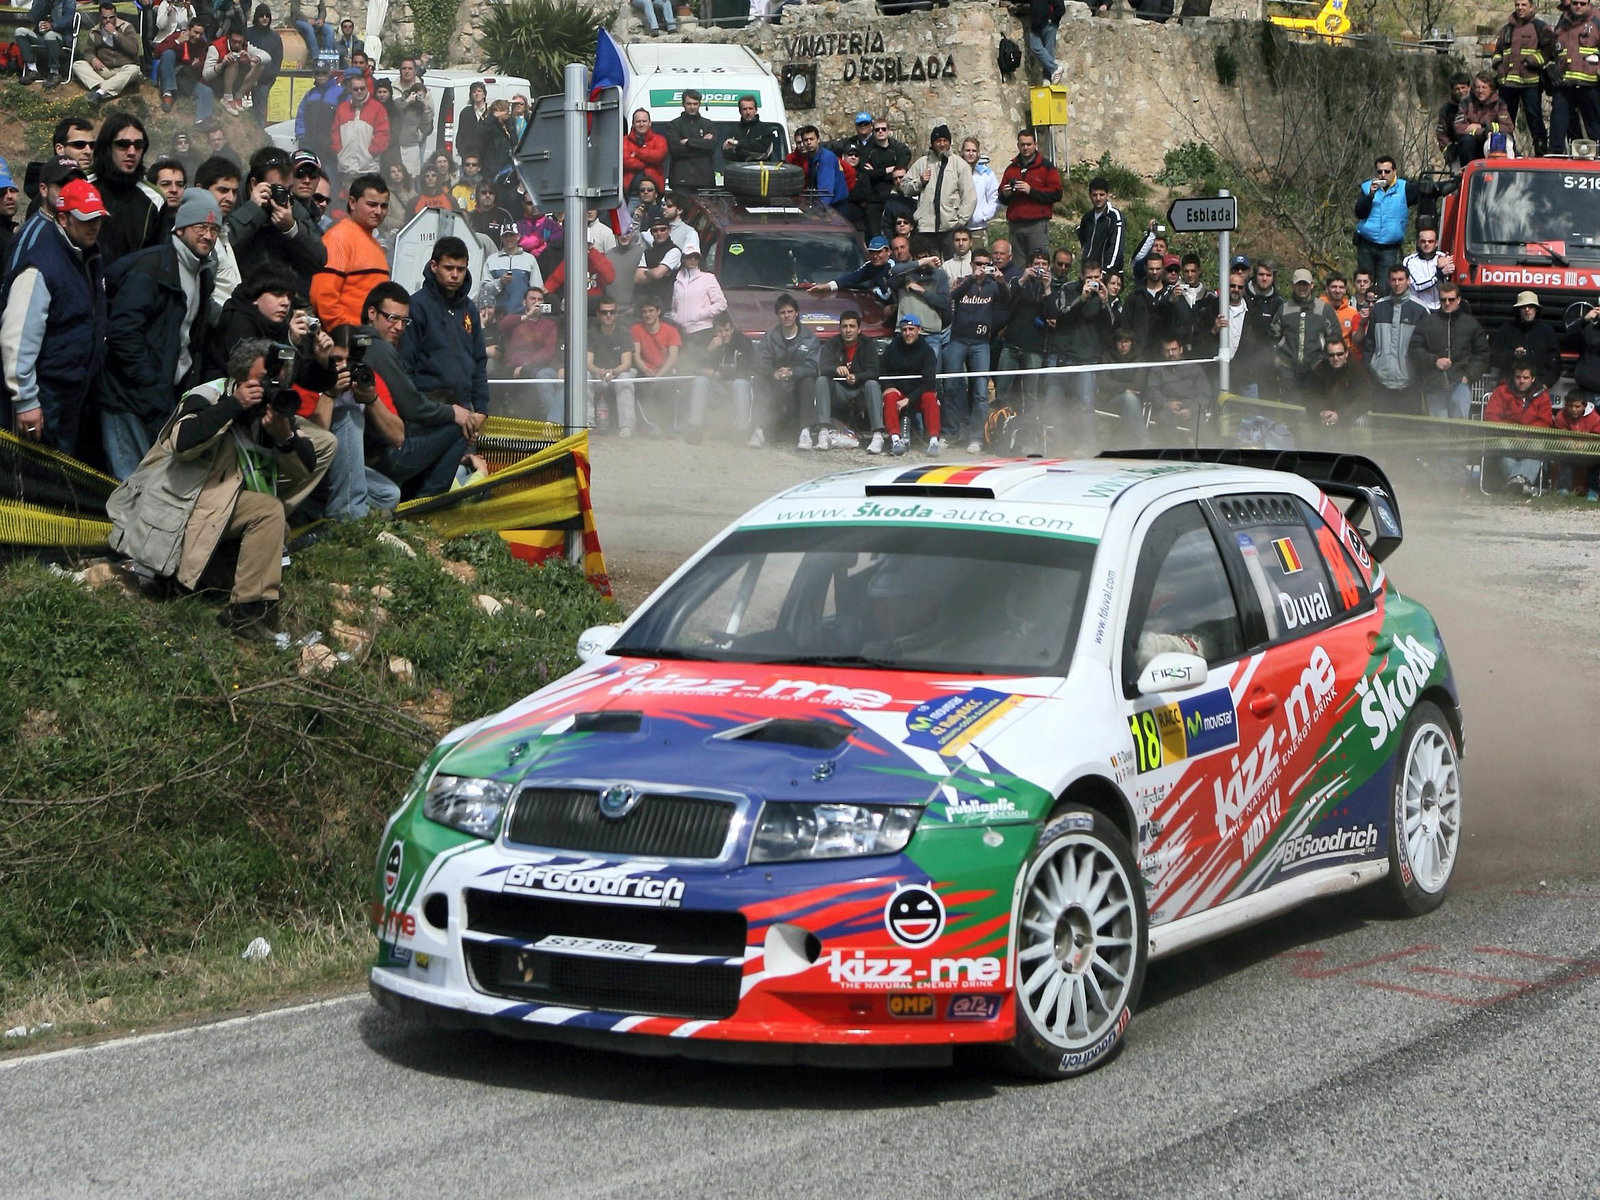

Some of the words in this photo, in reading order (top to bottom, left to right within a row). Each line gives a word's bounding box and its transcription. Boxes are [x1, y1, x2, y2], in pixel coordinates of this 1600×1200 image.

[1186, 207, 1231, 223] Esblada
[1482, 268, 1562, 286] bombers
[776, 501, 1074, 531] www.Škoda-auto.com
[1094, 569, 1118, 645] www.fduval.com
[1277, 581, 1333, 630] Duval
[607, 673, 893, 709] kizz-me
[1151, 666, 1193, 683] FIRST
[1354, 632, 1438, 750] Škoda
[1157, 708, 1182, 729] RACC
[1130, 711, 1161, 772] 18
[1213, 645, 1337, 839] kizz-me
[1246, 763, 1283, 813] NATURAL
[1282, 721, 1312, 765] ENERGY
[1312, 686, 1338, 723] DRINK
[1282, 823, 1378, 866] BFGoodrich
[505, 864, 686, 900] BFGoodrich
[827, 950, 1001, 983] kizz-me
[840, 981, 861, 989] THE
[864, 981, 913, 990] NATURAL
[916, 980, 958, 989] ENERGY
[961, 980, 994, 988] DRINK
[890, 996, 932, 1013] OMP
